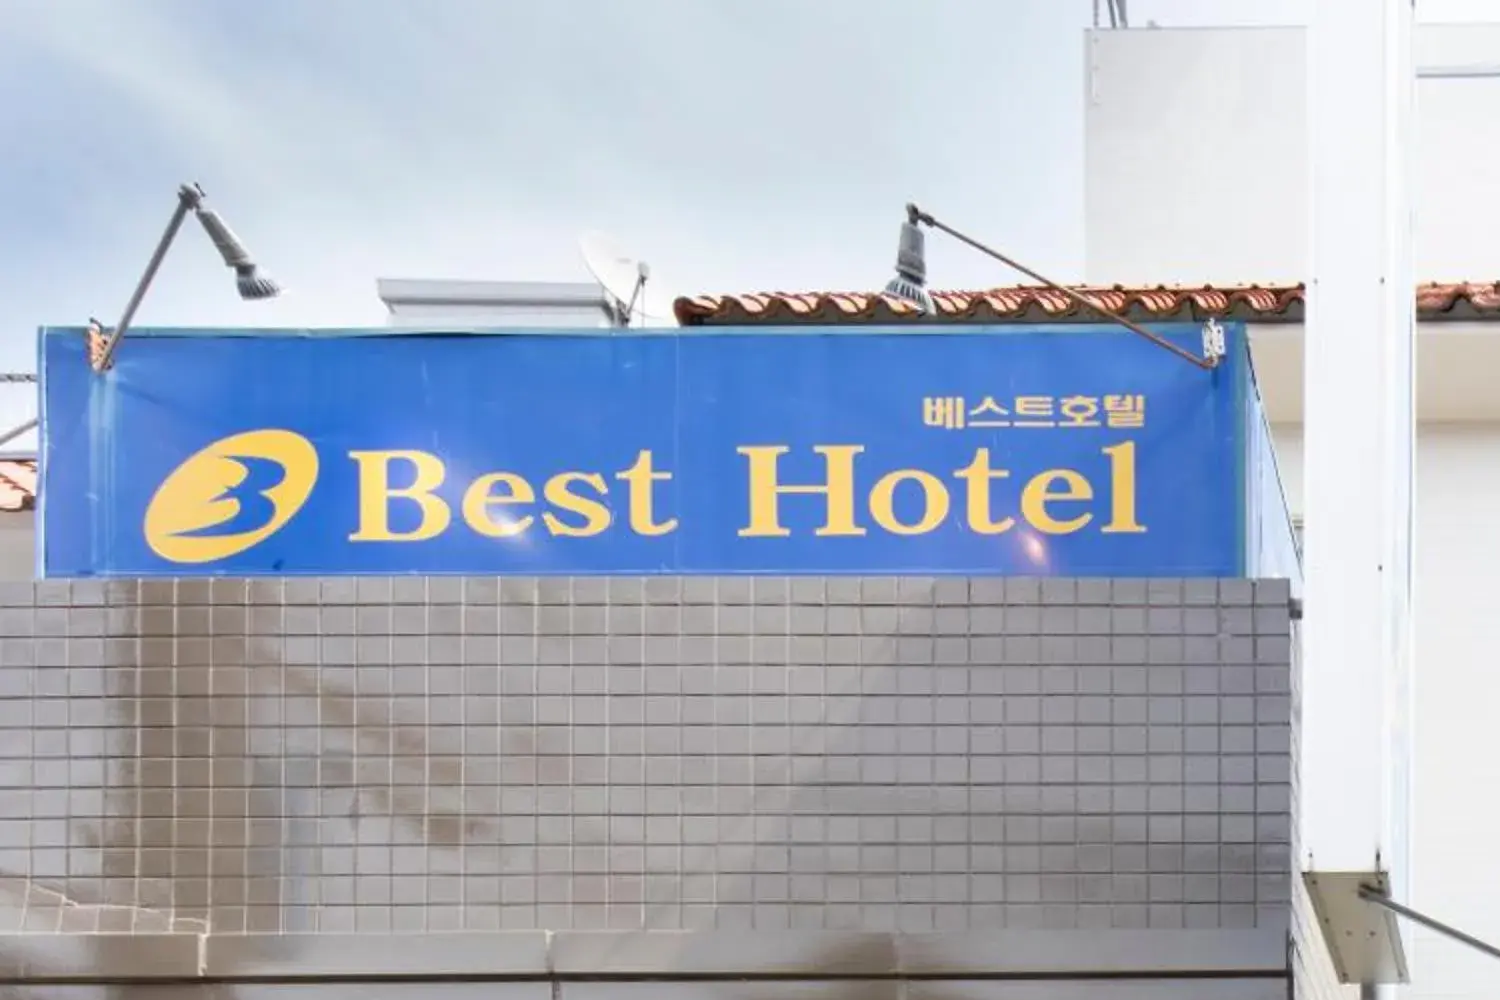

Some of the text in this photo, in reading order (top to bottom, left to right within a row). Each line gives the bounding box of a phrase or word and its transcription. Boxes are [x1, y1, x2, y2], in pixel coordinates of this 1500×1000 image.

[923, 395, 1145, 430] 베스트호텔
[348, 440, 1148, 541] Best Hotel
